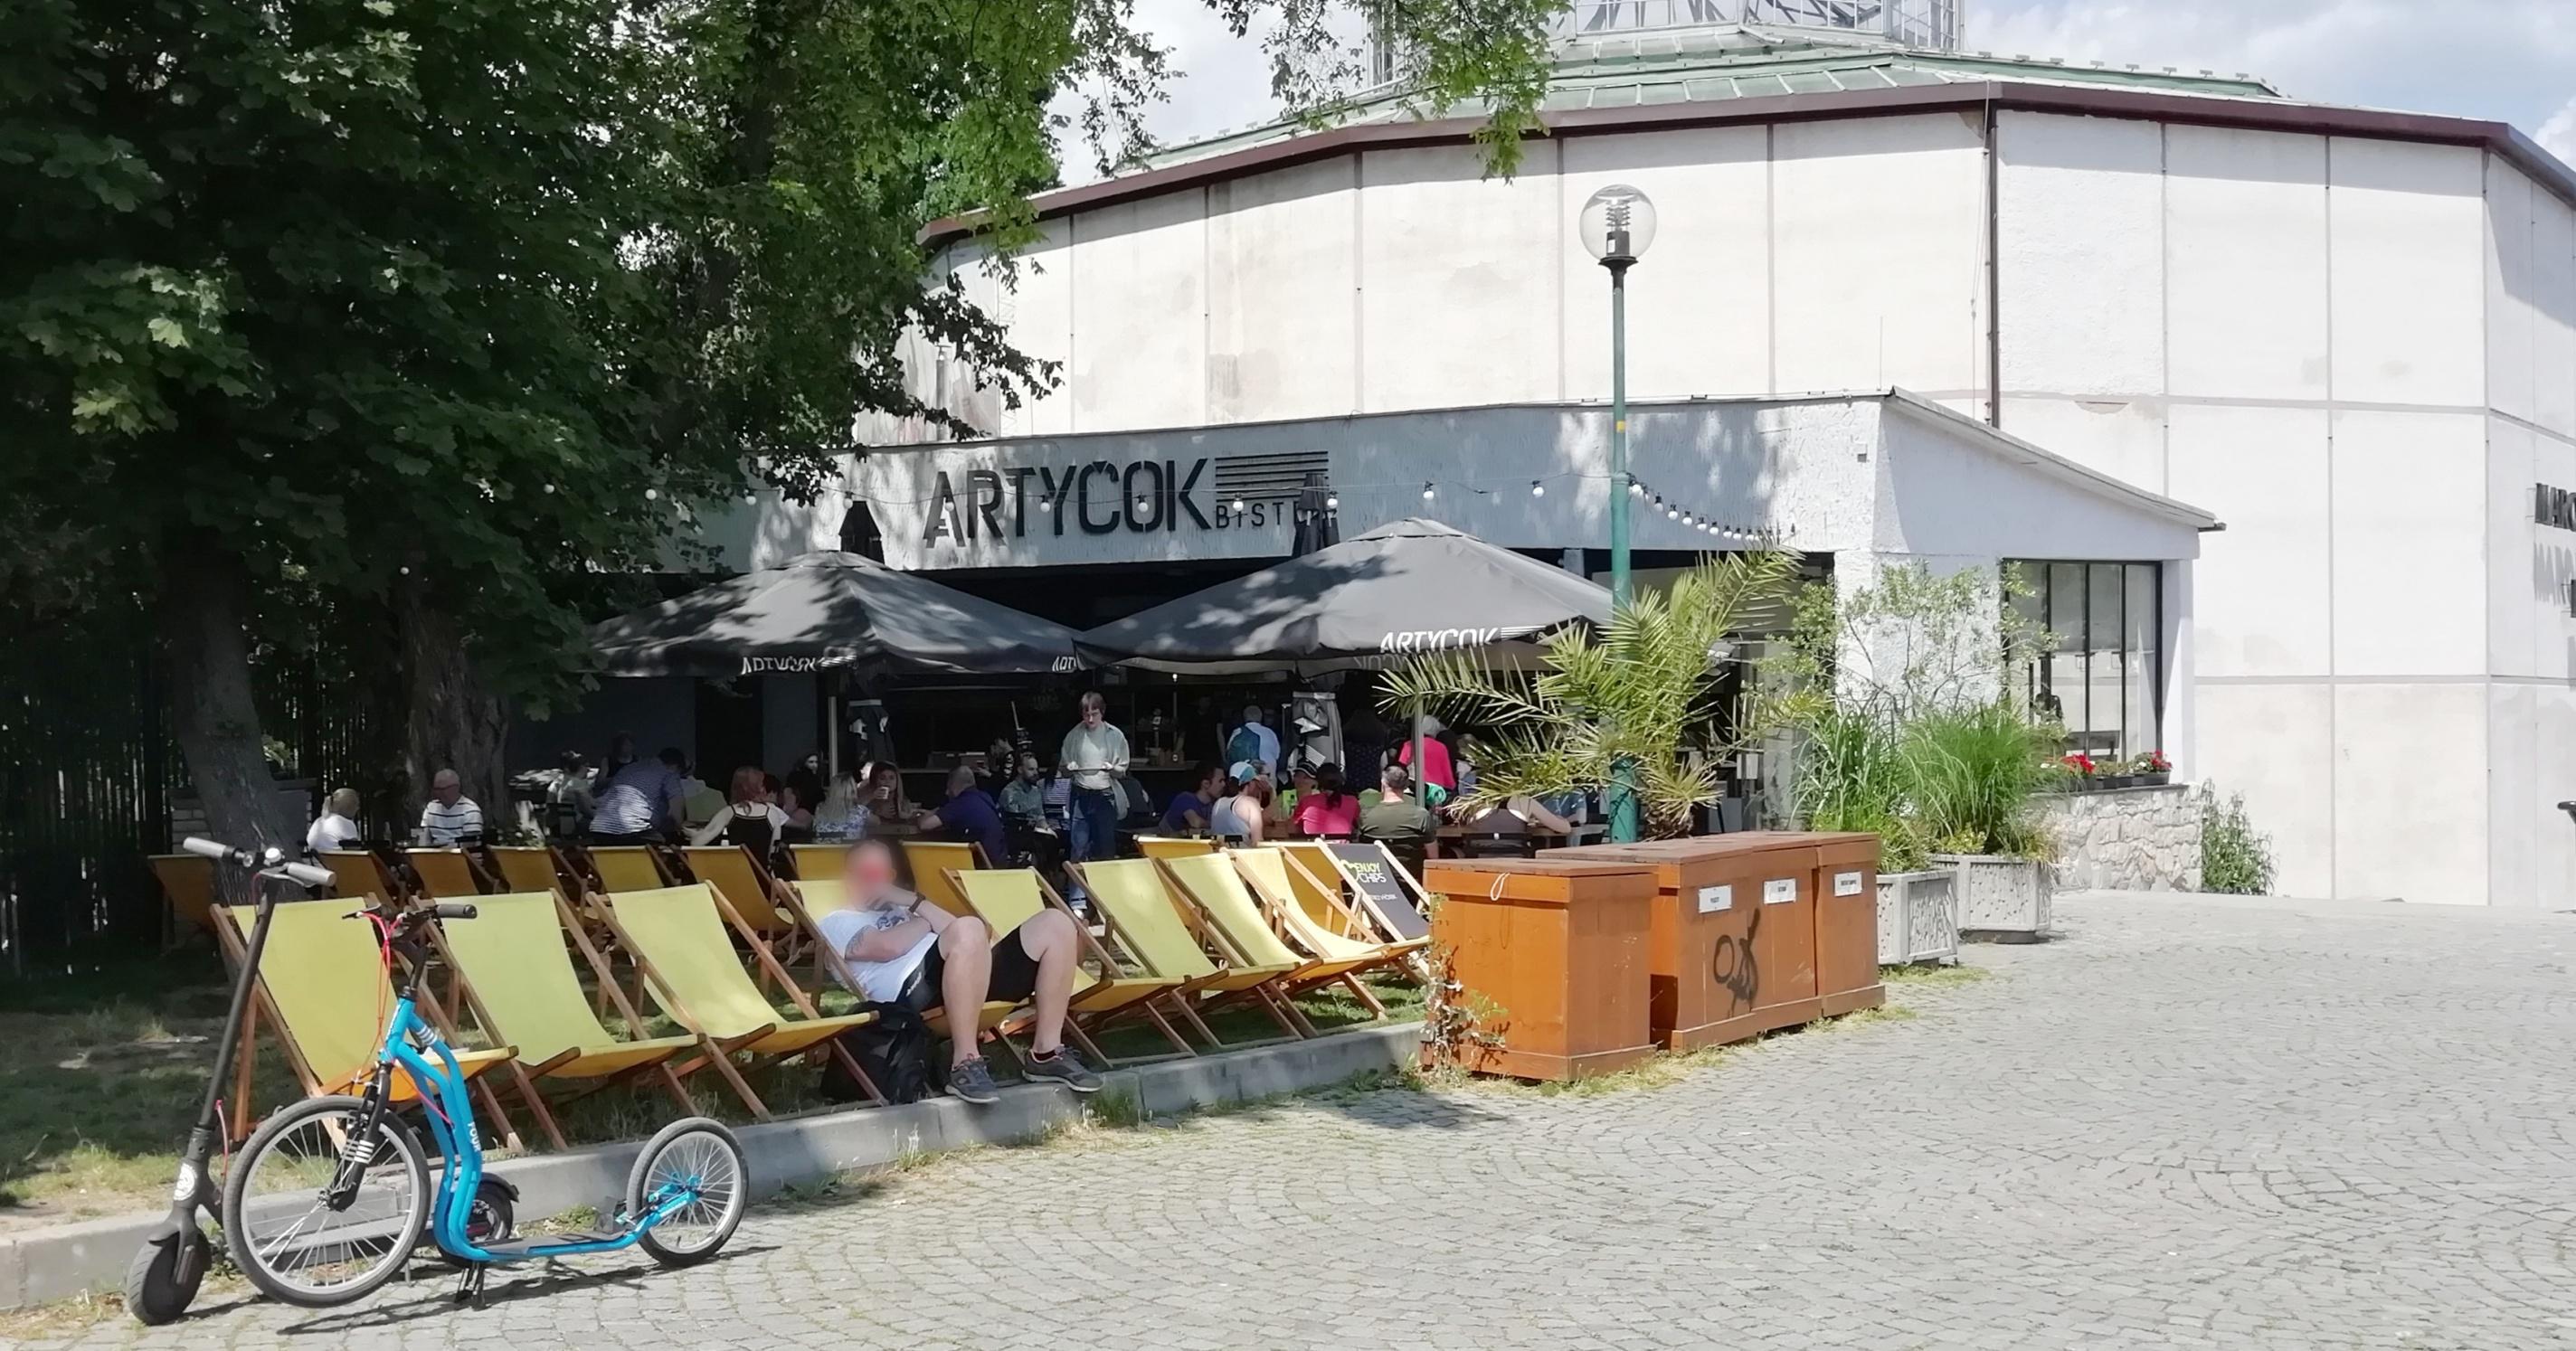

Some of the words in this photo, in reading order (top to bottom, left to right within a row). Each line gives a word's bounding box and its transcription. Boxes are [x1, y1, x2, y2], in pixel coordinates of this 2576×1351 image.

[923, 458, 1212, 548] ARTYCOK
[1216, 499, 1322, 529] BIST
[1379, 628, 1499, 654] ARTYCOK
[1359, 872, 1387, 883] CHIPS
[467, 1120, 482, 1153] FOUR
